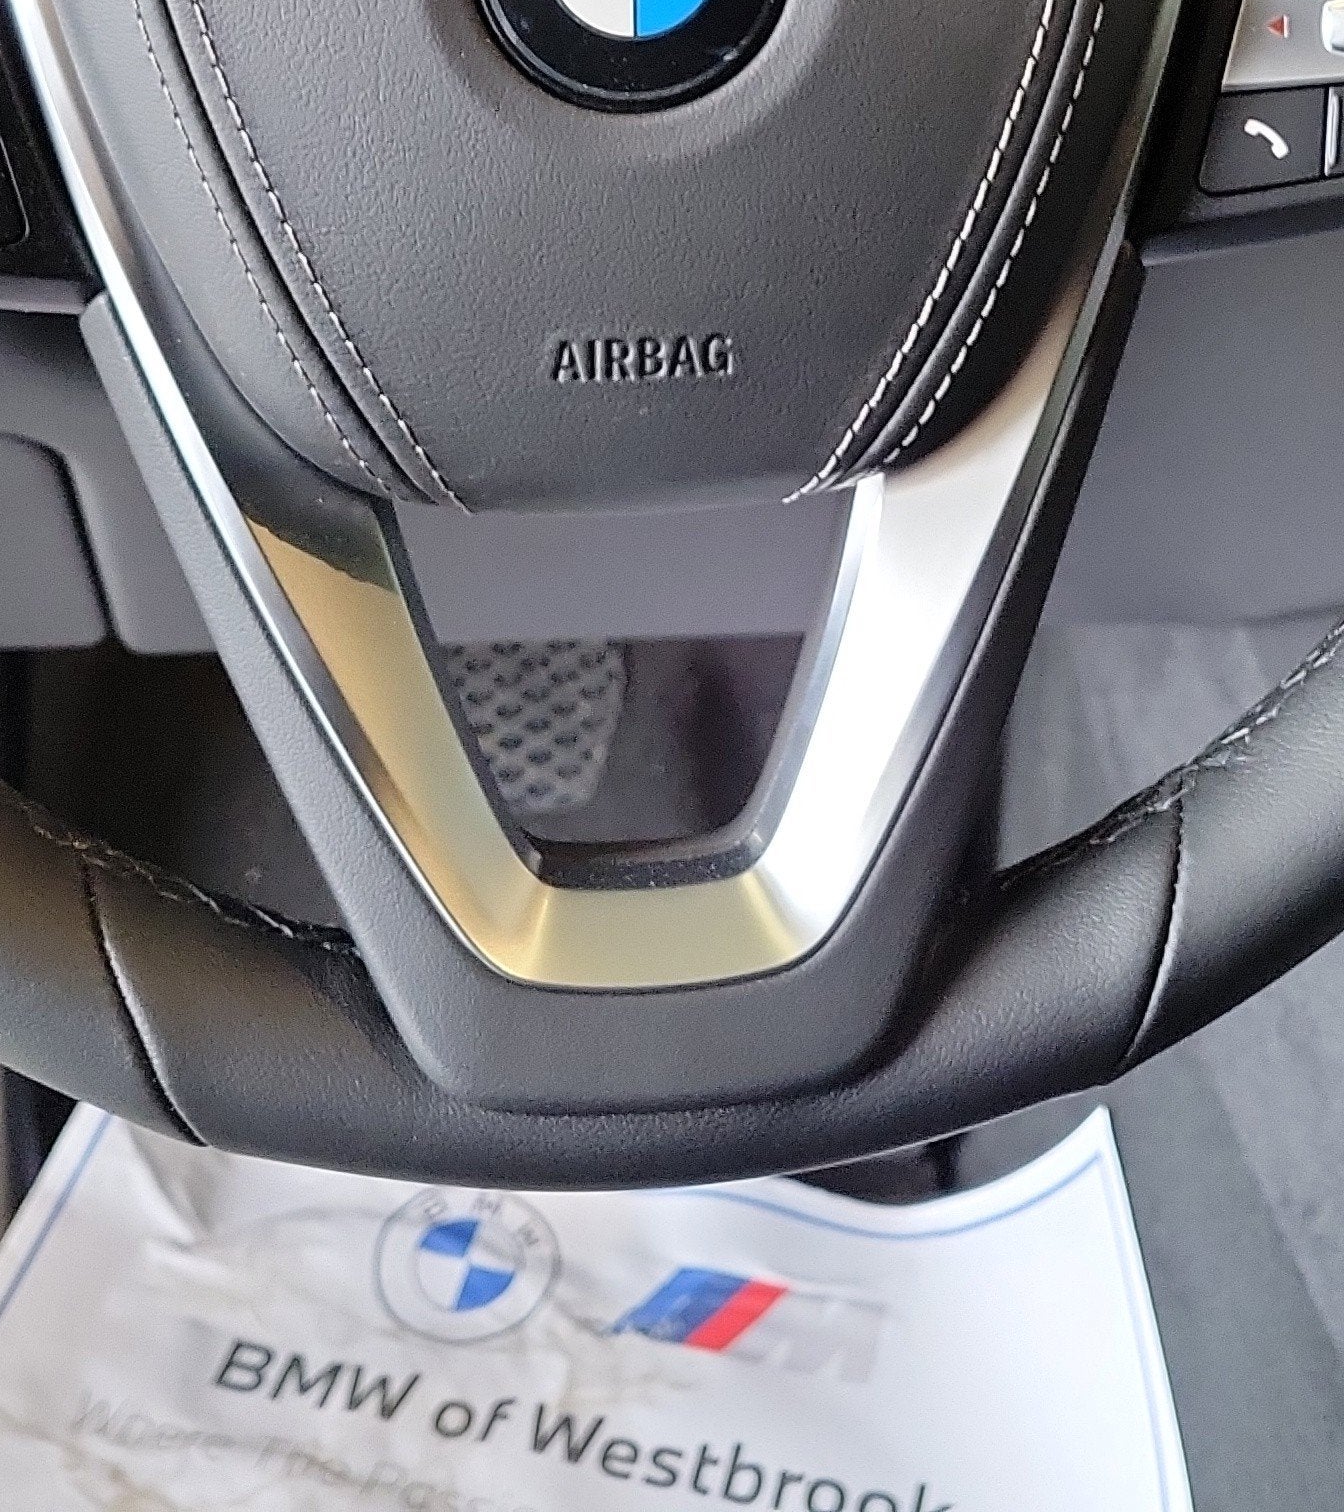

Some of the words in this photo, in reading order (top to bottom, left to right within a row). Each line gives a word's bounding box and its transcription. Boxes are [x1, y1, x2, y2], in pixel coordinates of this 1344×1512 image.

[551, 333, 734, 383] AIRBAG
[215, 1338, 421, 1420] BMW
[434, 1398, 518, 1444] of
